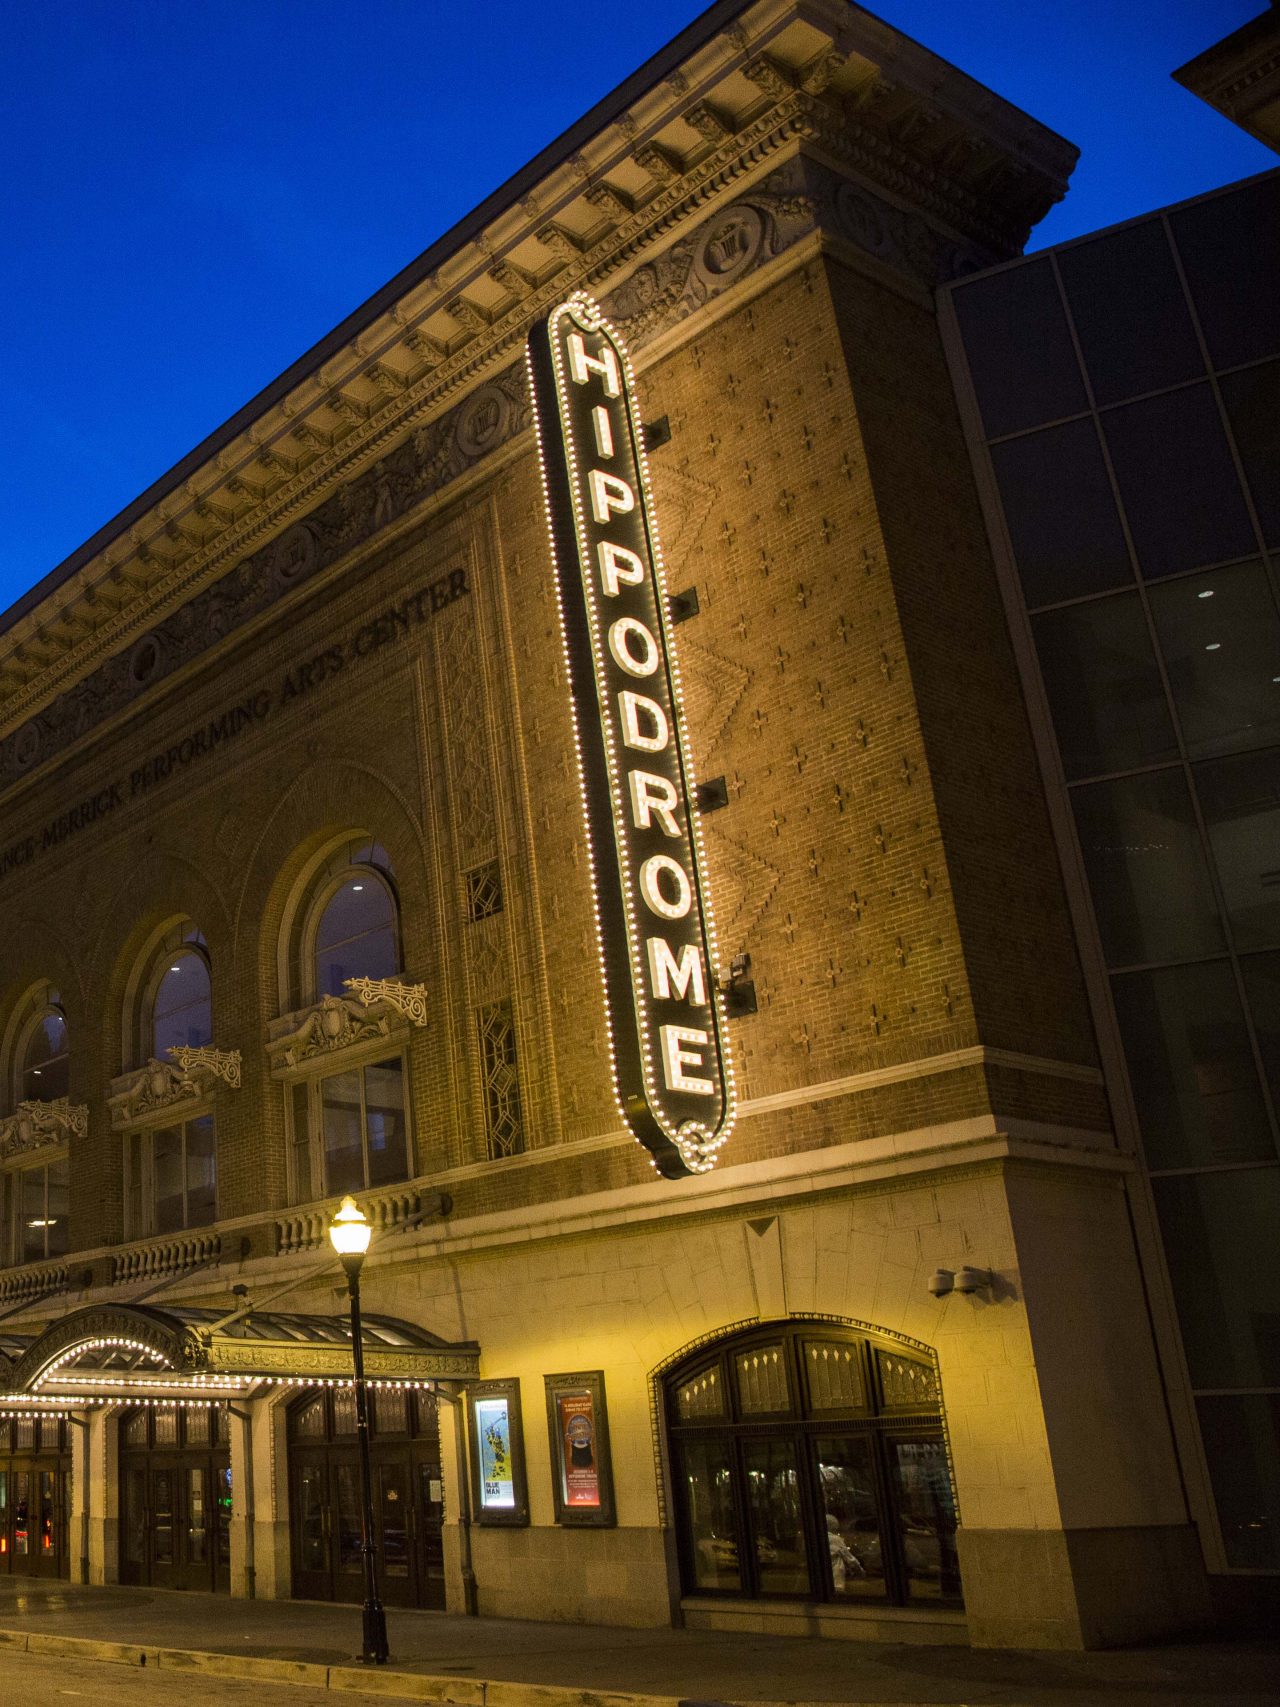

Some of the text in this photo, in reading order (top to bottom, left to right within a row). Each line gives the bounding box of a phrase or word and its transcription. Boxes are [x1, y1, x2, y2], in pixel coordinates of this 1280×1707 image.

[128, 690, 271, 796] PERFORMING
[279, 643, 347, 708] ARTS
[351, 566, 471, 660] CENTER
[569, 334, 715, 1096] HIPPODROME
